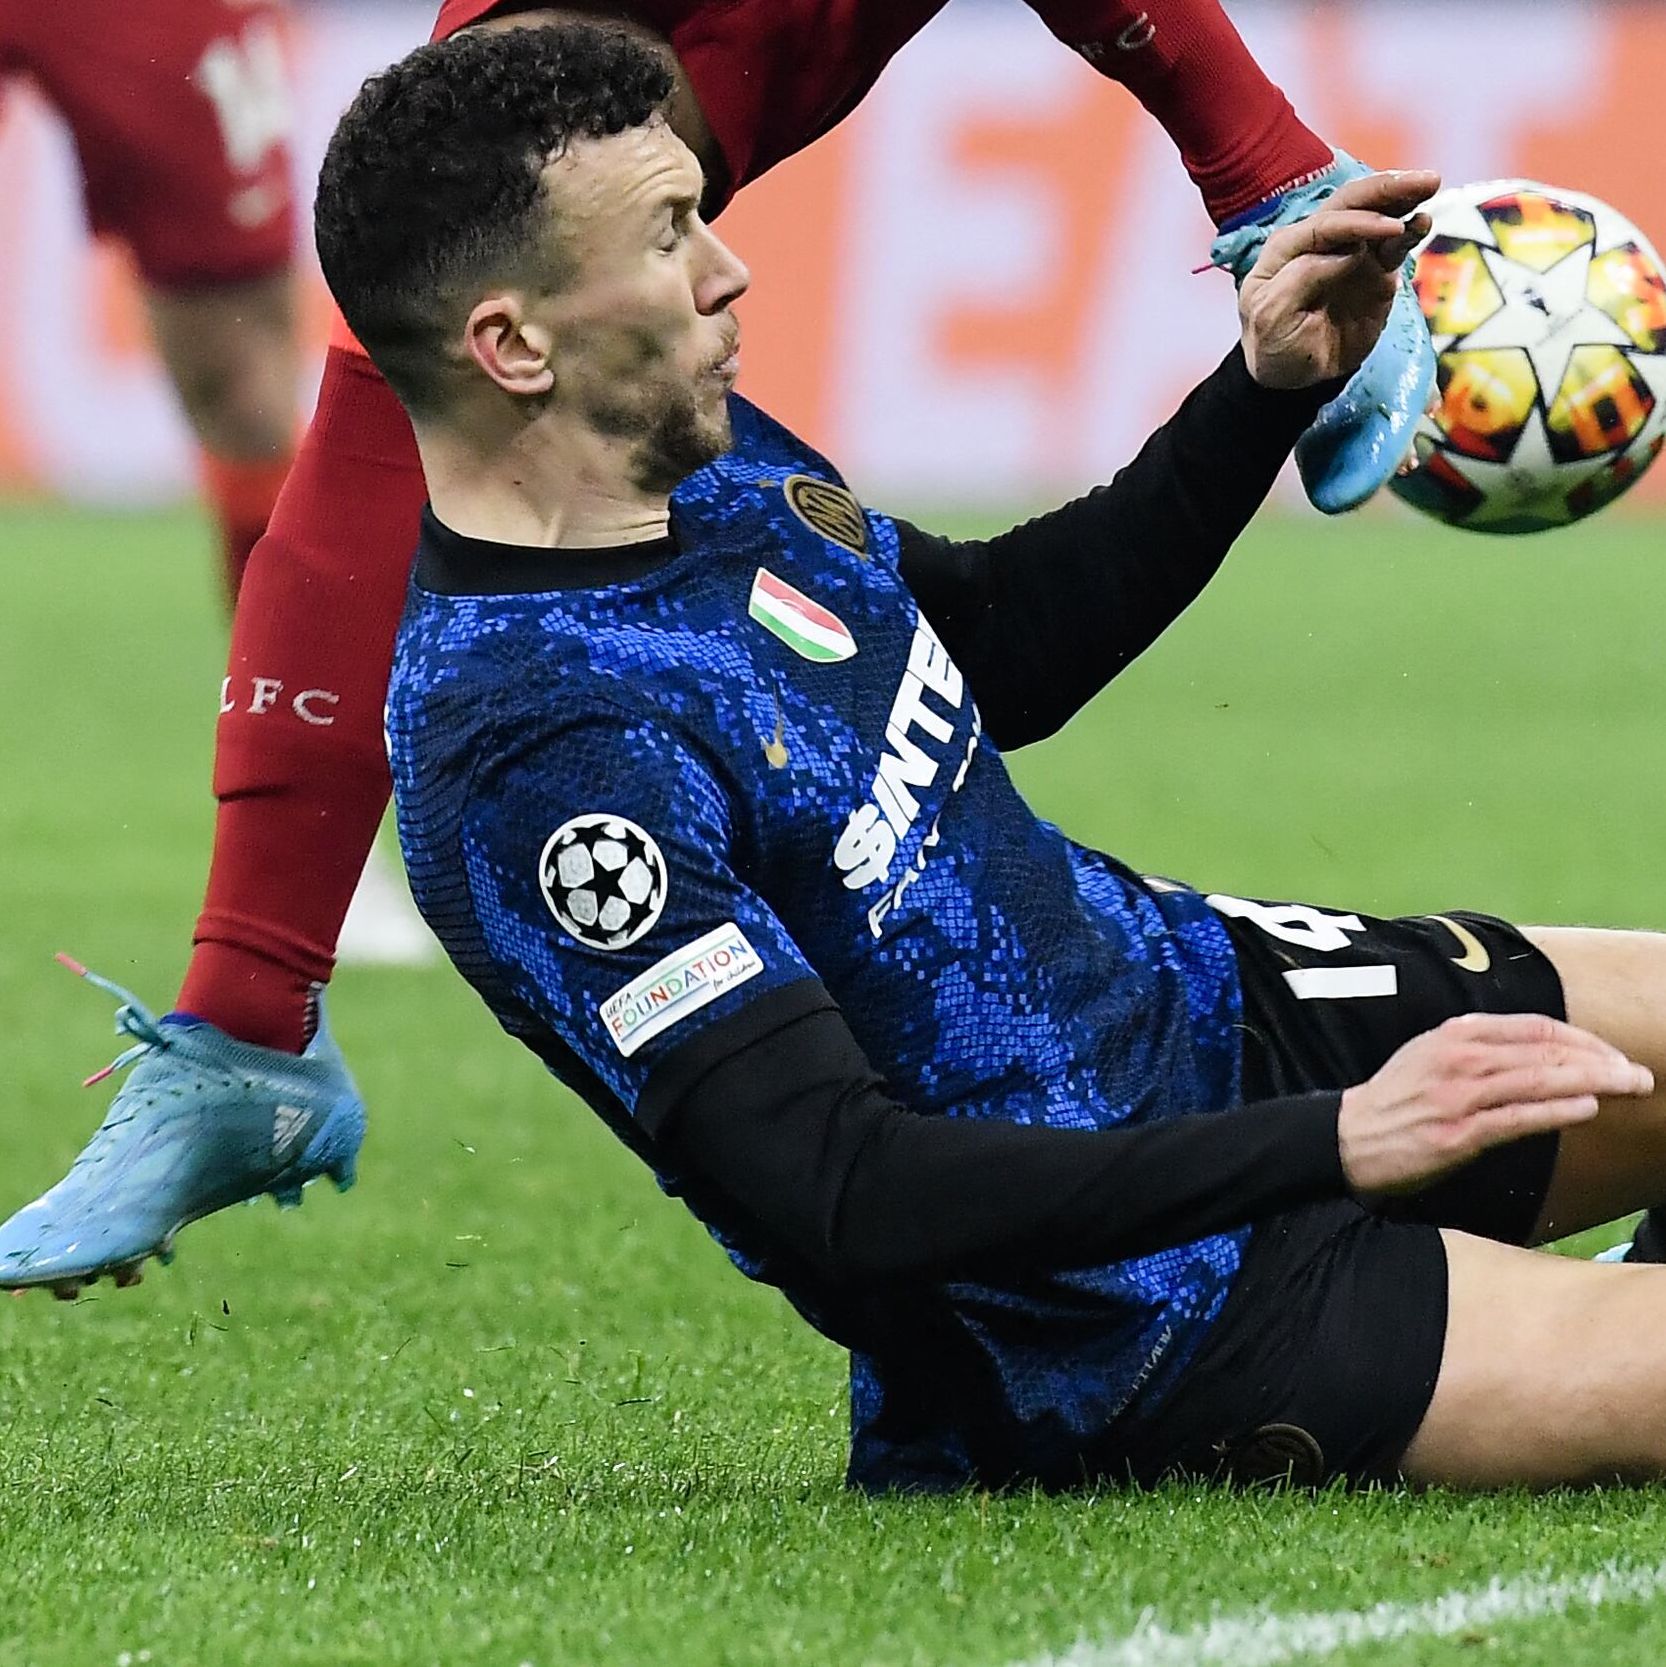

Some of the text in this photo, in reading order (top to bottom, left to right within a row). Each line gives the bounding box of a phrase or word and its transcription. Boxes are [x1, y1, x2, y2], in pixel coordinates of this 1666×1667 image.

[834, 607, 963, 890] $INTE
[605, 991, 632, 1019] UEFA
[611, 939, 748, 1037] FOUNDATION
